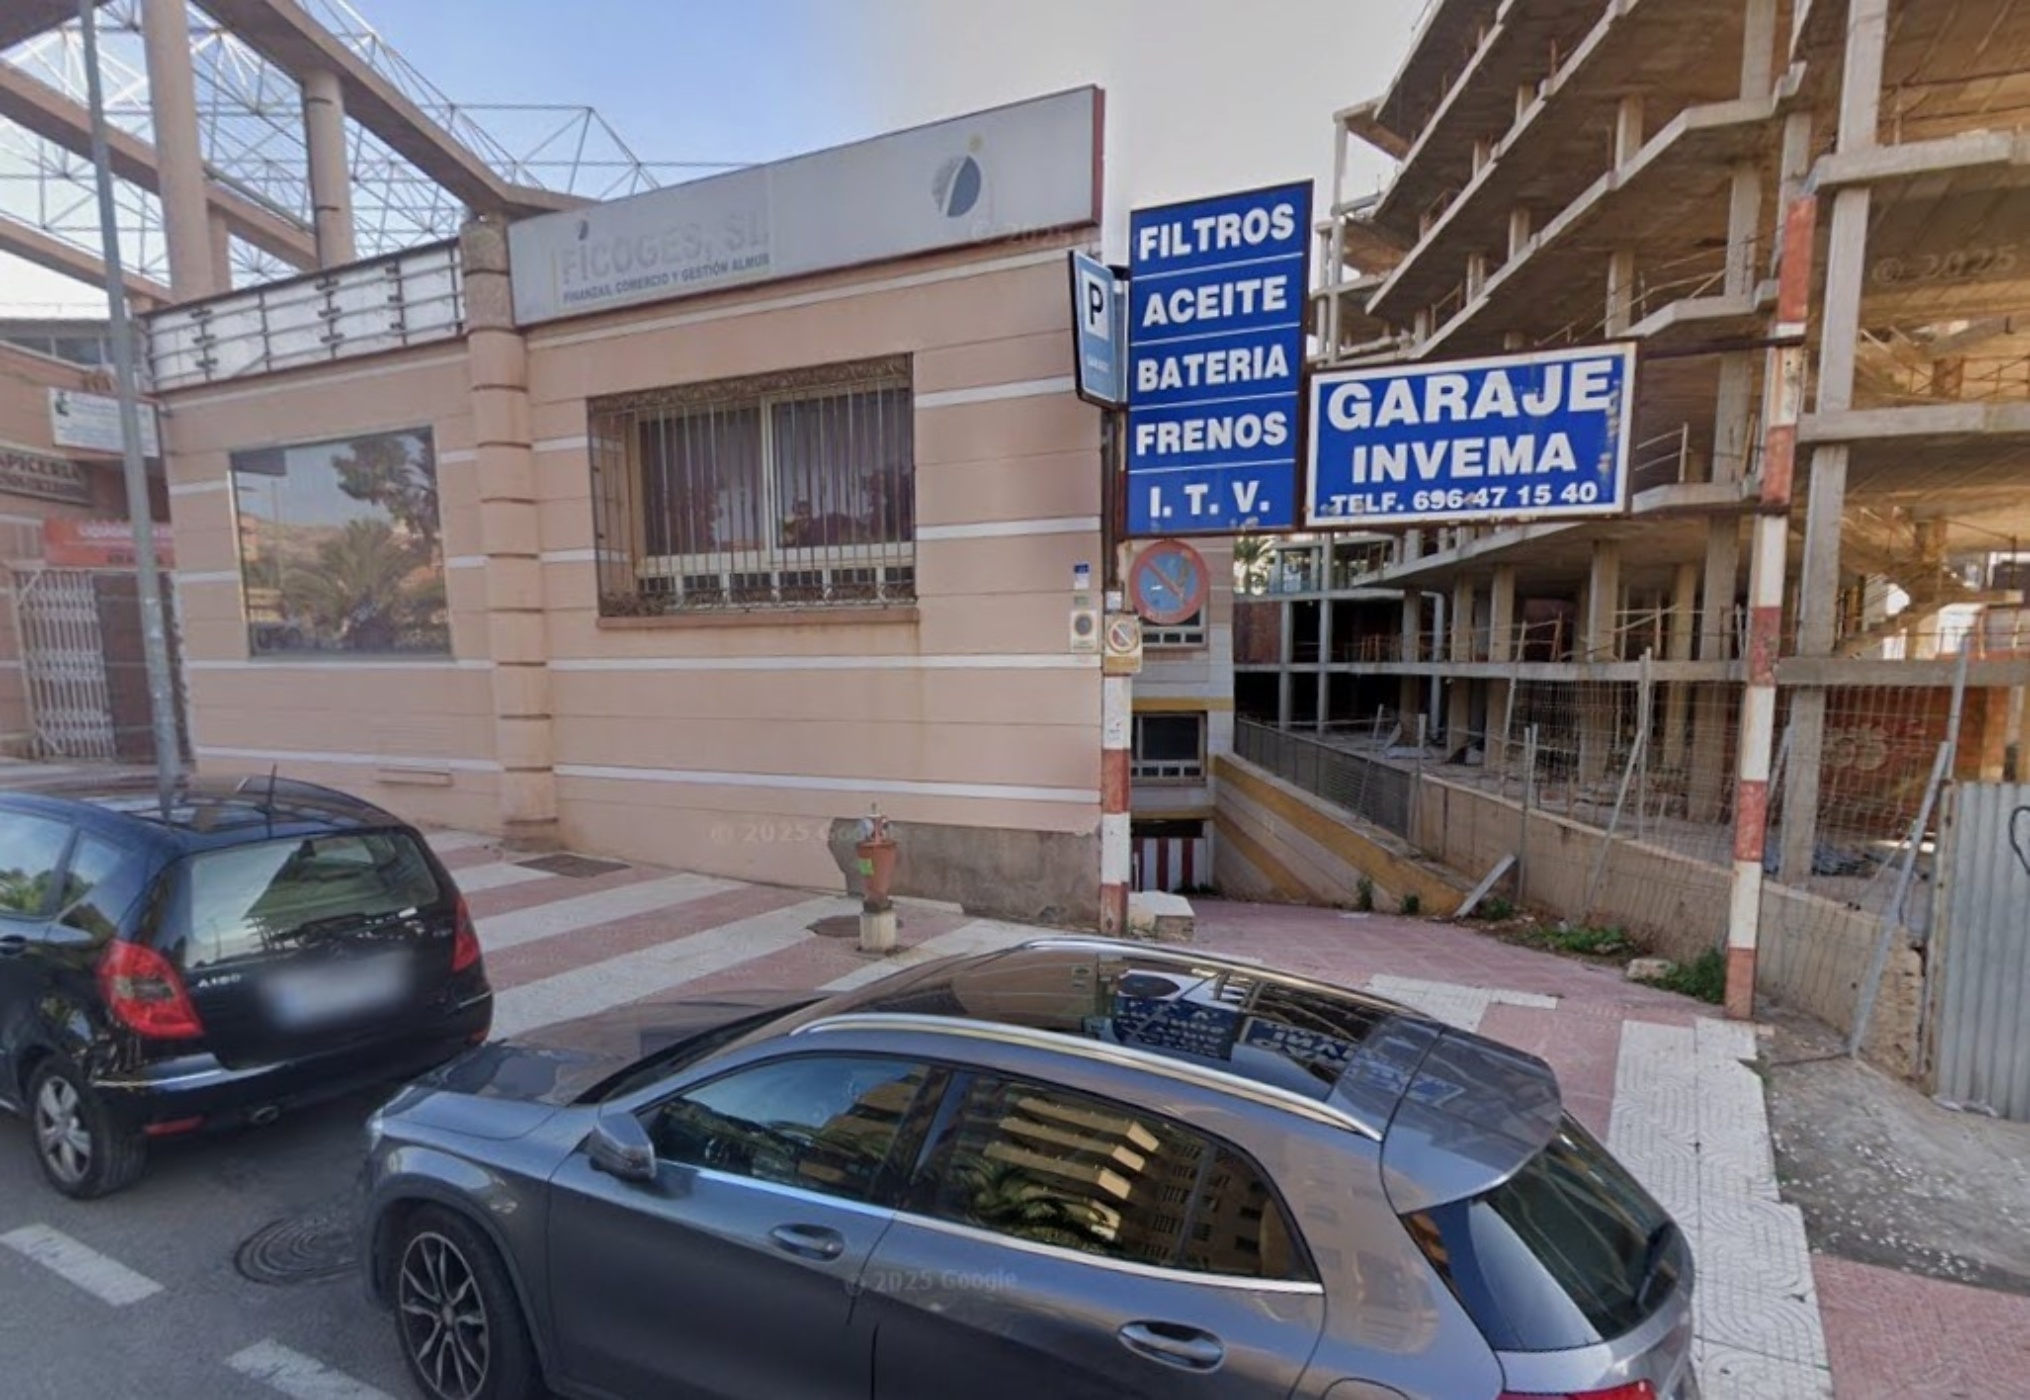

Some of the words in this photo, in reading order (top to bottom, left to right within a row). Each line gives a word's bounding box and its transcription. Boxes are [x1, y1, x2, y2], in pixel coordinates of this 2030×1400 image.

[1138, 202, 1296, 262] FILTROS
[615, 273, 670, 295] COMERCIO
[1088, 281, 1104, 326] P
[1142, 274, 1288, 327] ACEITE
[1136, 344, 1289, 392] BATERIA
[1327, 359, 1613, 431] GARAJE
[1136, 411, 1288, 456] FRENOS
[1352, 432, 1577, 484] INVEMA
[1330, 491, 1404, 515] TELF.
[1517, 485, 1551, 506] 15
[1561, 481, 1597, 503] 40
